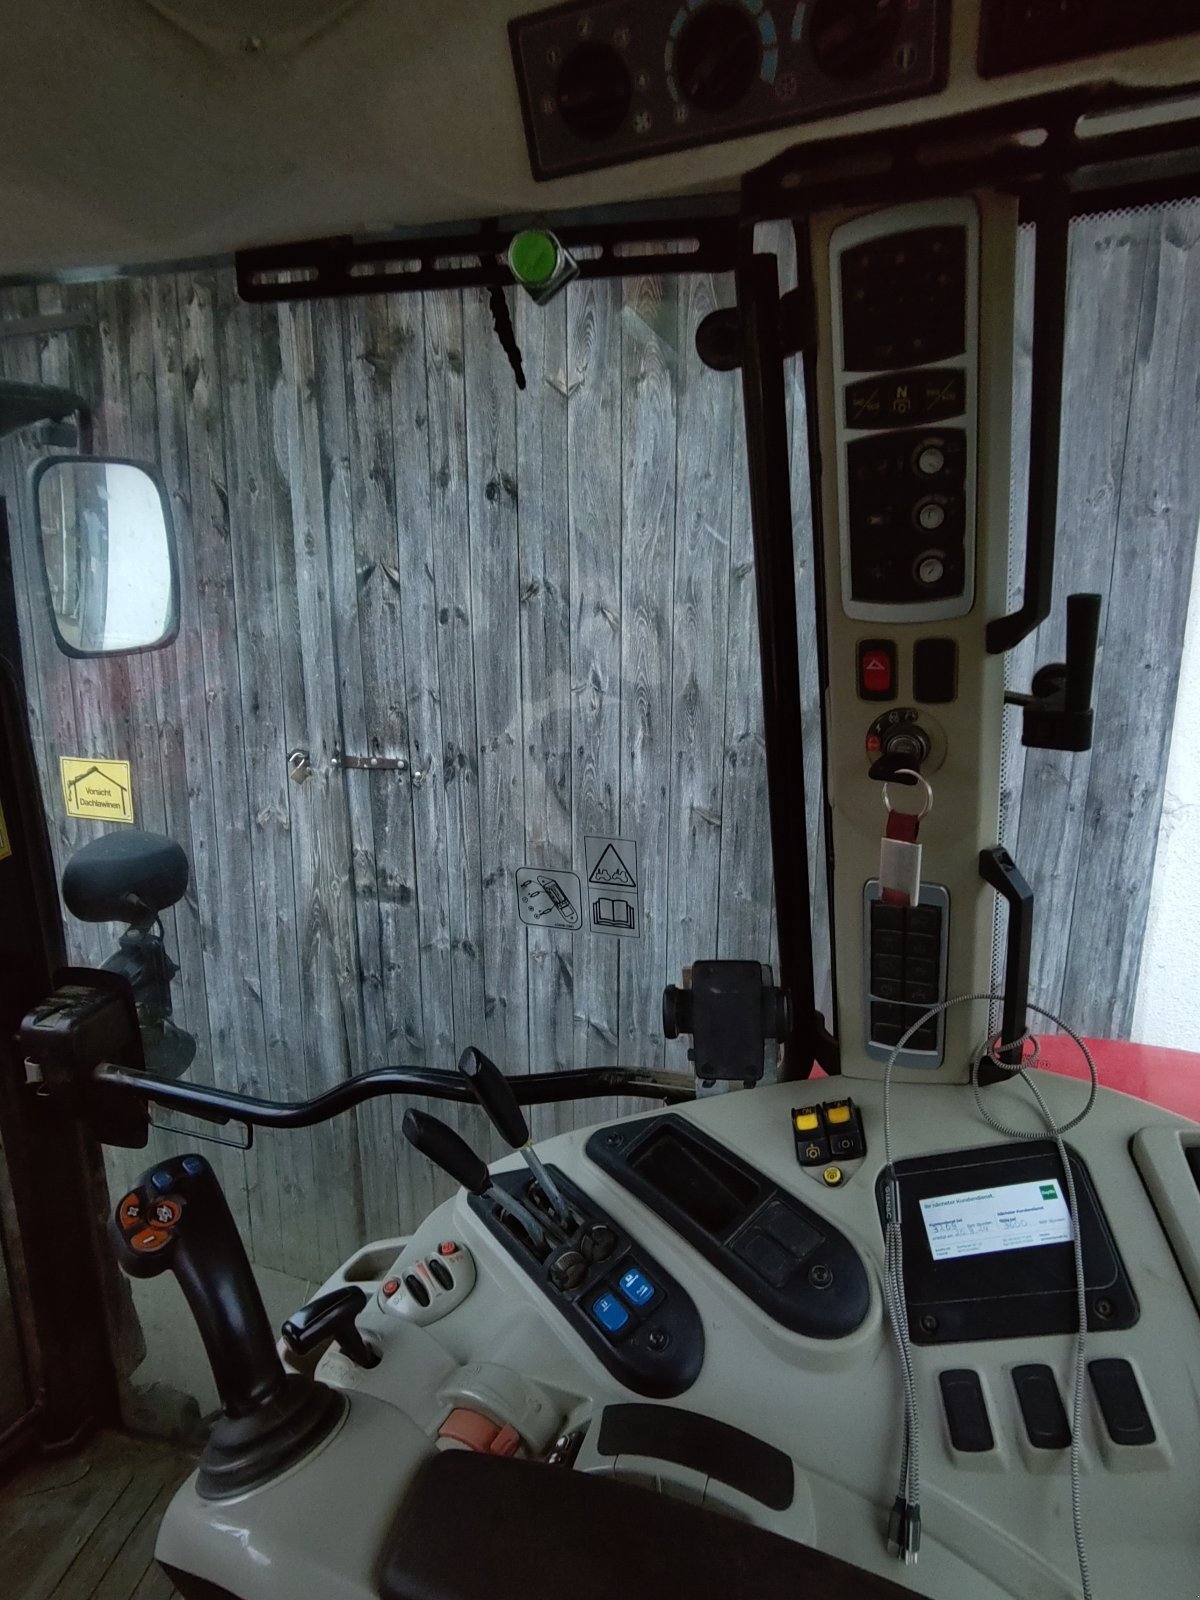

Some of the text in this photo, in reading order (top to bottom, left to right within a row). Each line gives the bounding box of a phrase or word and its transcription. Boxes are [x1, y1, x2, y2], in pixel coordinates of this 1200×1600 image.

[896, 385, 908, 398] N
[85, 787, 112, 797] Vorsicht
[80, 798, 121, 809] Dachlawinen
